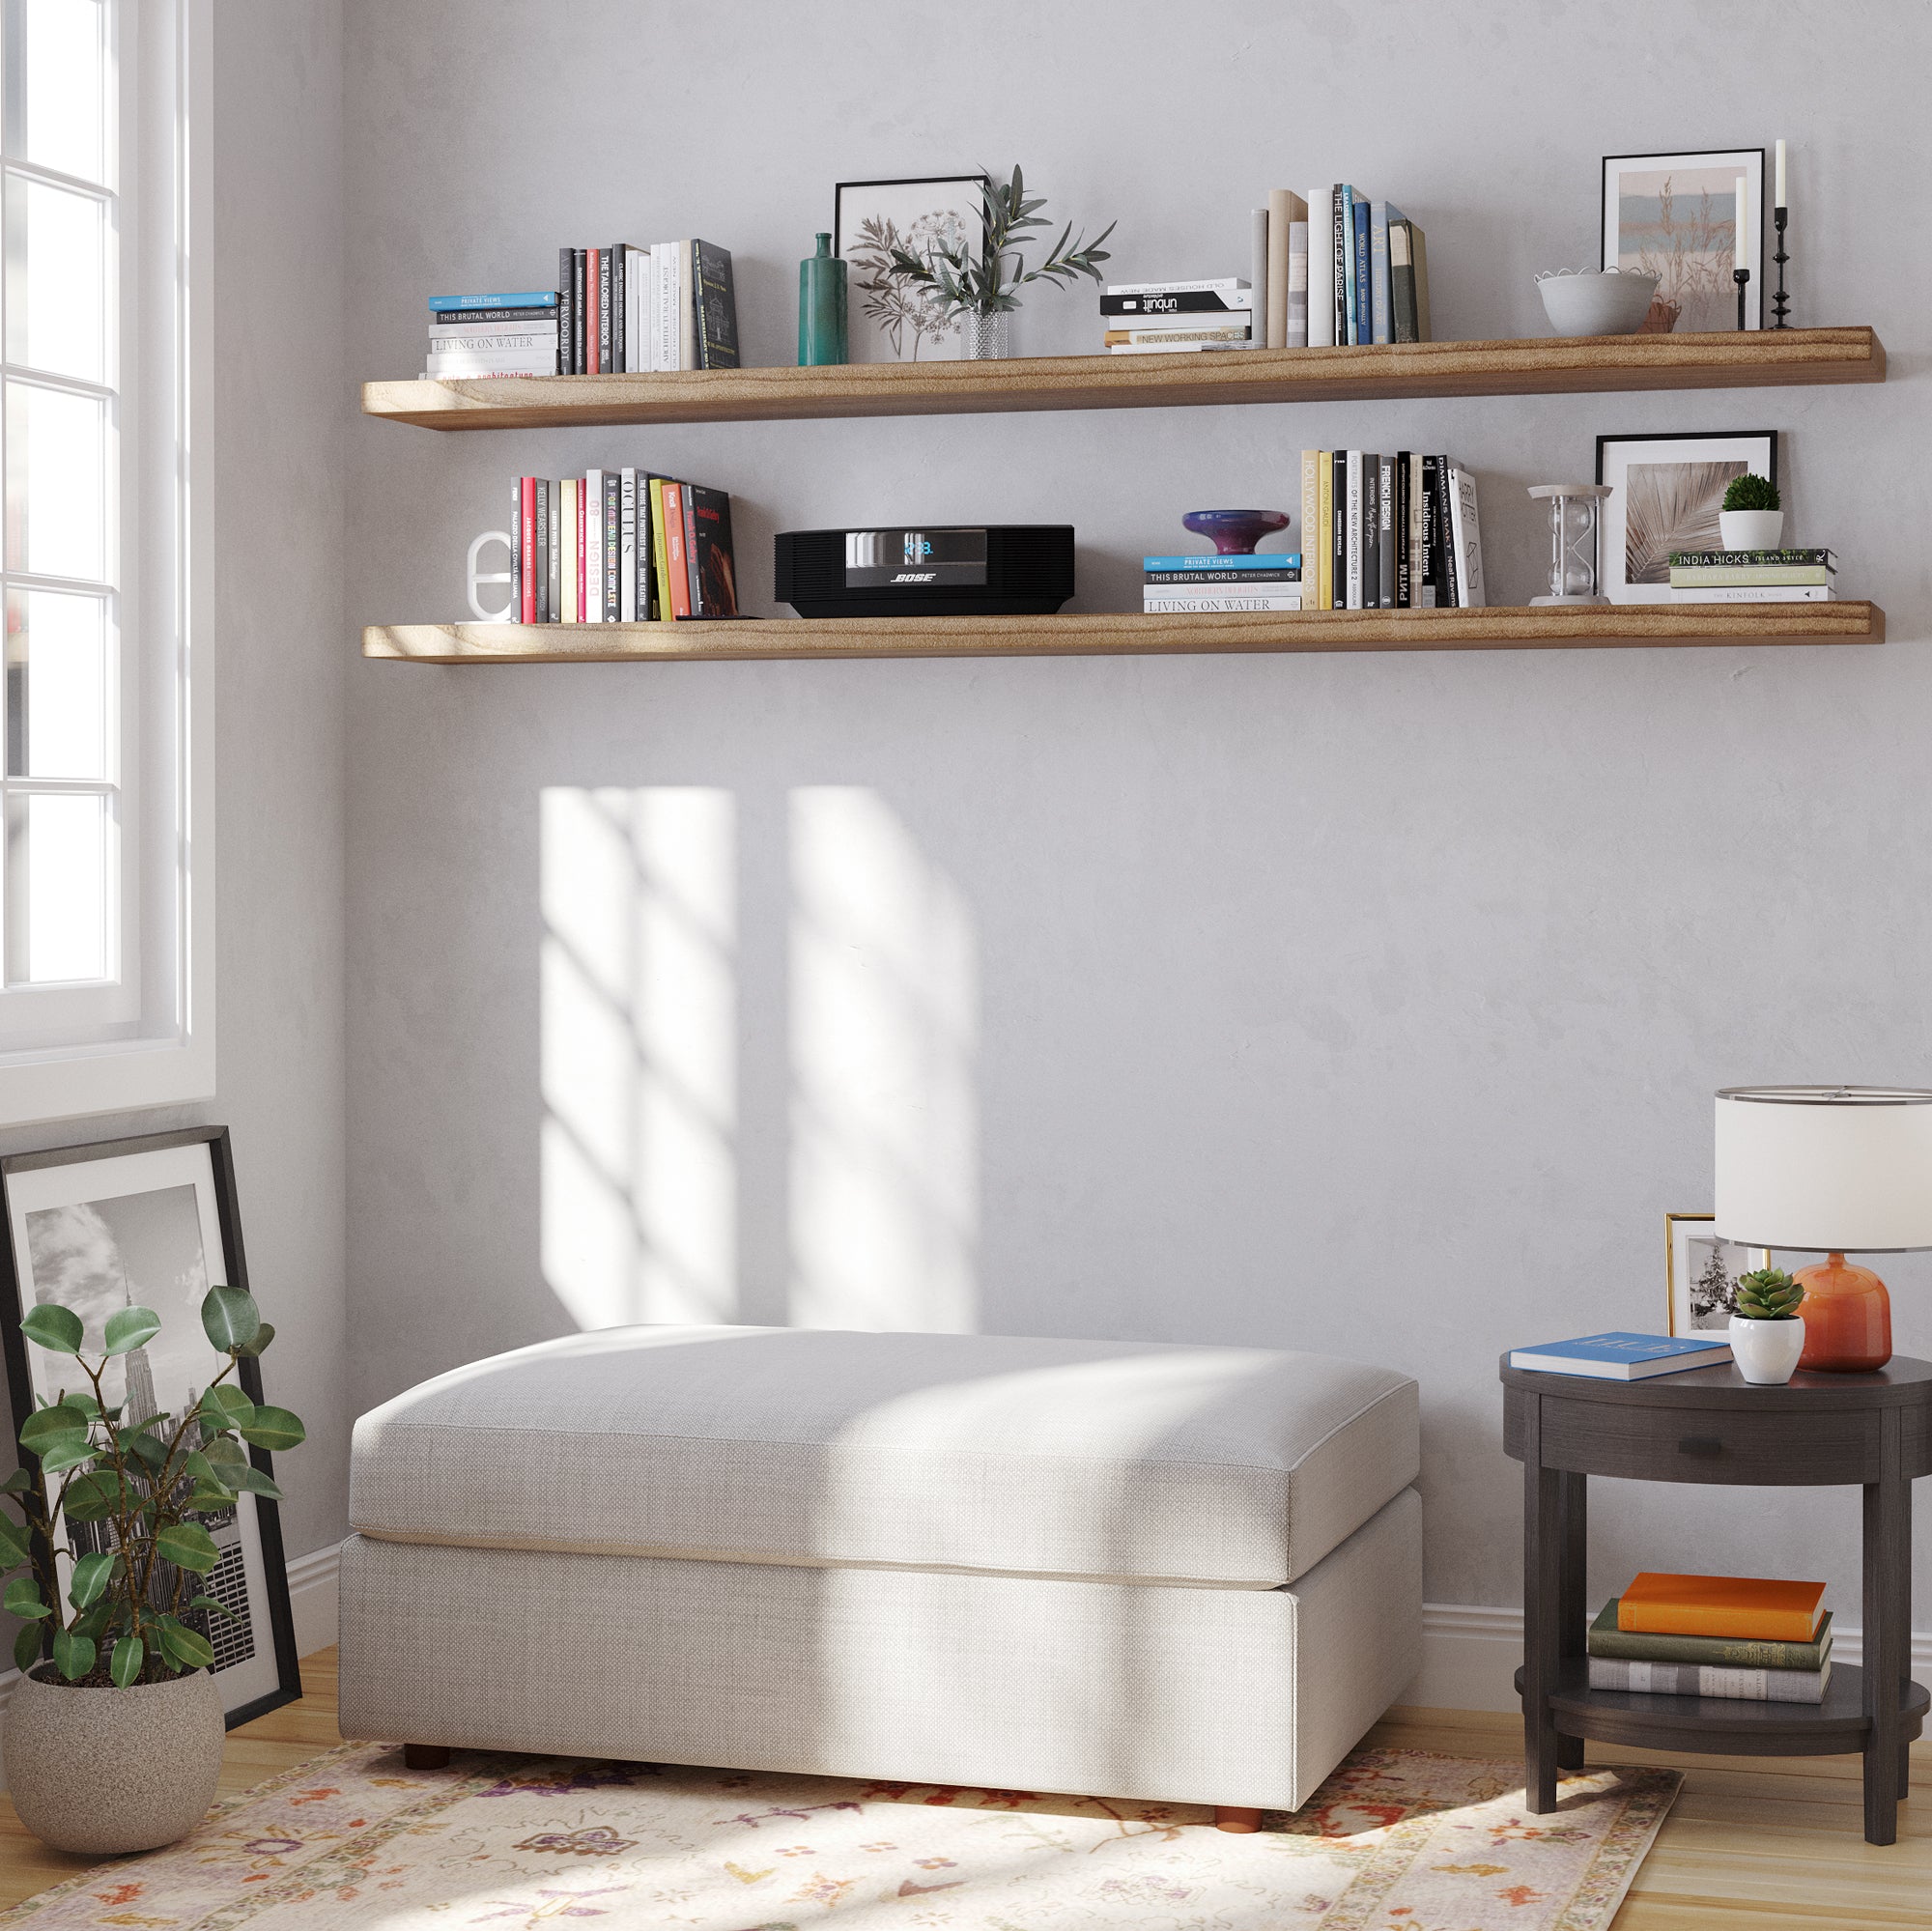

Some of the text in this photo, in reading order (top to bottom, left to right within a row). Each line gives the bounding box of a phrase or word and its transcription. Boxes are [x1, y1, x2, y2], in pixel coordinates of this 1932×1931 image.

[1335, 214, 1344, 245] LIGHT
[1374, 224, 1385, 255] ART
[1336, 248, 1345, 263] OF
[560, 254, 570, 284] AXEL
[601, 256, 610, 346] THE TAILORED INTERIOR
[1143, 298, 1178, 313] unbuilt
[560, 290, 570, 361] VERVOORDT
[1142, 330, 1245, 344] NEW WORKING SPACES
[436, 336, 533, 350] LIVING ON WATER
[1350, 490, 1357, 498] OF
[1381, 465, 1391, 530] FRENCH DESIGN
[1438, 456, 1449, 514] DIMMANS
[668, 492, 676, 507] Knoll
[687, 511, 696, 531] Frank
[1305, 460, 1316, 592] HOLLYWOOD INTERIORS
[1422, 491, 1432, 576] Insidious Intent
[589, 500, 600, 596] DESIGN 80
[656, 532, 665, 560] Japanese
[689, 540, 697, 564] Gehry
[1679, 555, 1711, 565] INDIA
[1714, 554, 1749, 564] HICKS
[890, 573, 937, 583] BOSE
[1151, 573, 1171, 582] THIS
[1399, 564, 1407, 601] РИТМ
[1149, 599, 1270, 611] LIVING ON WATER
